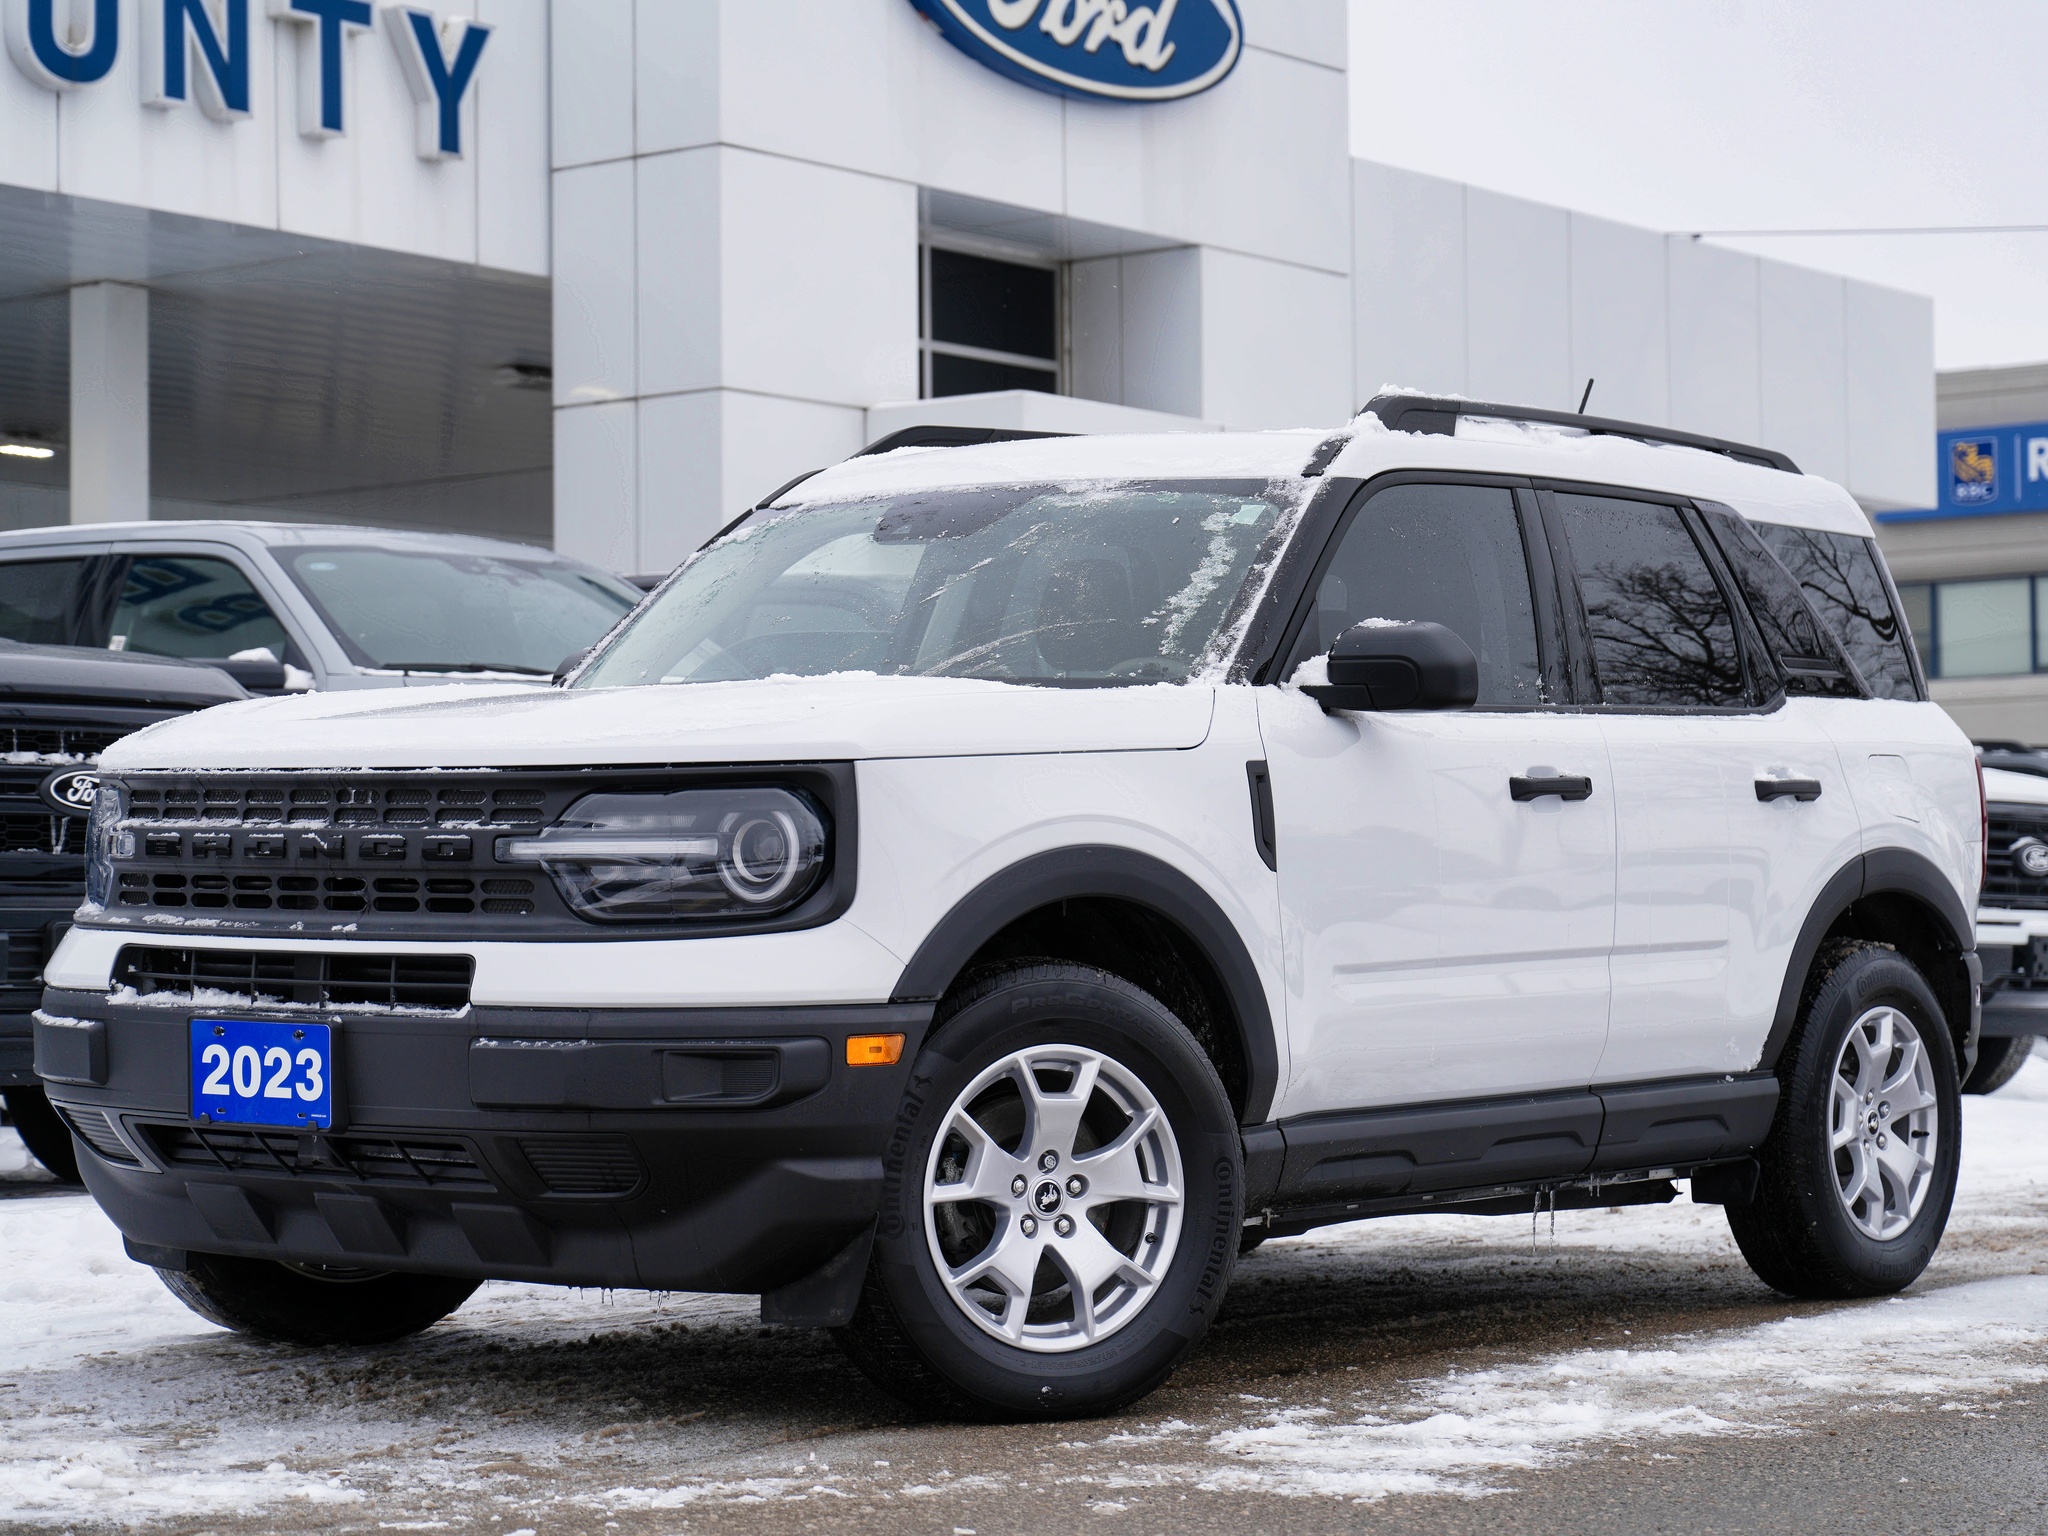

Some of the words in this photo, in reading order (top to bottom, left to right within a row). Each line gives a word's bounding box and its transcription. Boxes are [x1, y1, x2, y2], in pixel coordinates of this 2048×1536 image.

[27, 0, 491, 155] UNTY
[144, 832, 474, 862] BRONCO
[202, 1044, 323, 1102] 2023
[882, 1088, 926, 1240] Continental
[1196, 1156, 1235, 1300] Continental
